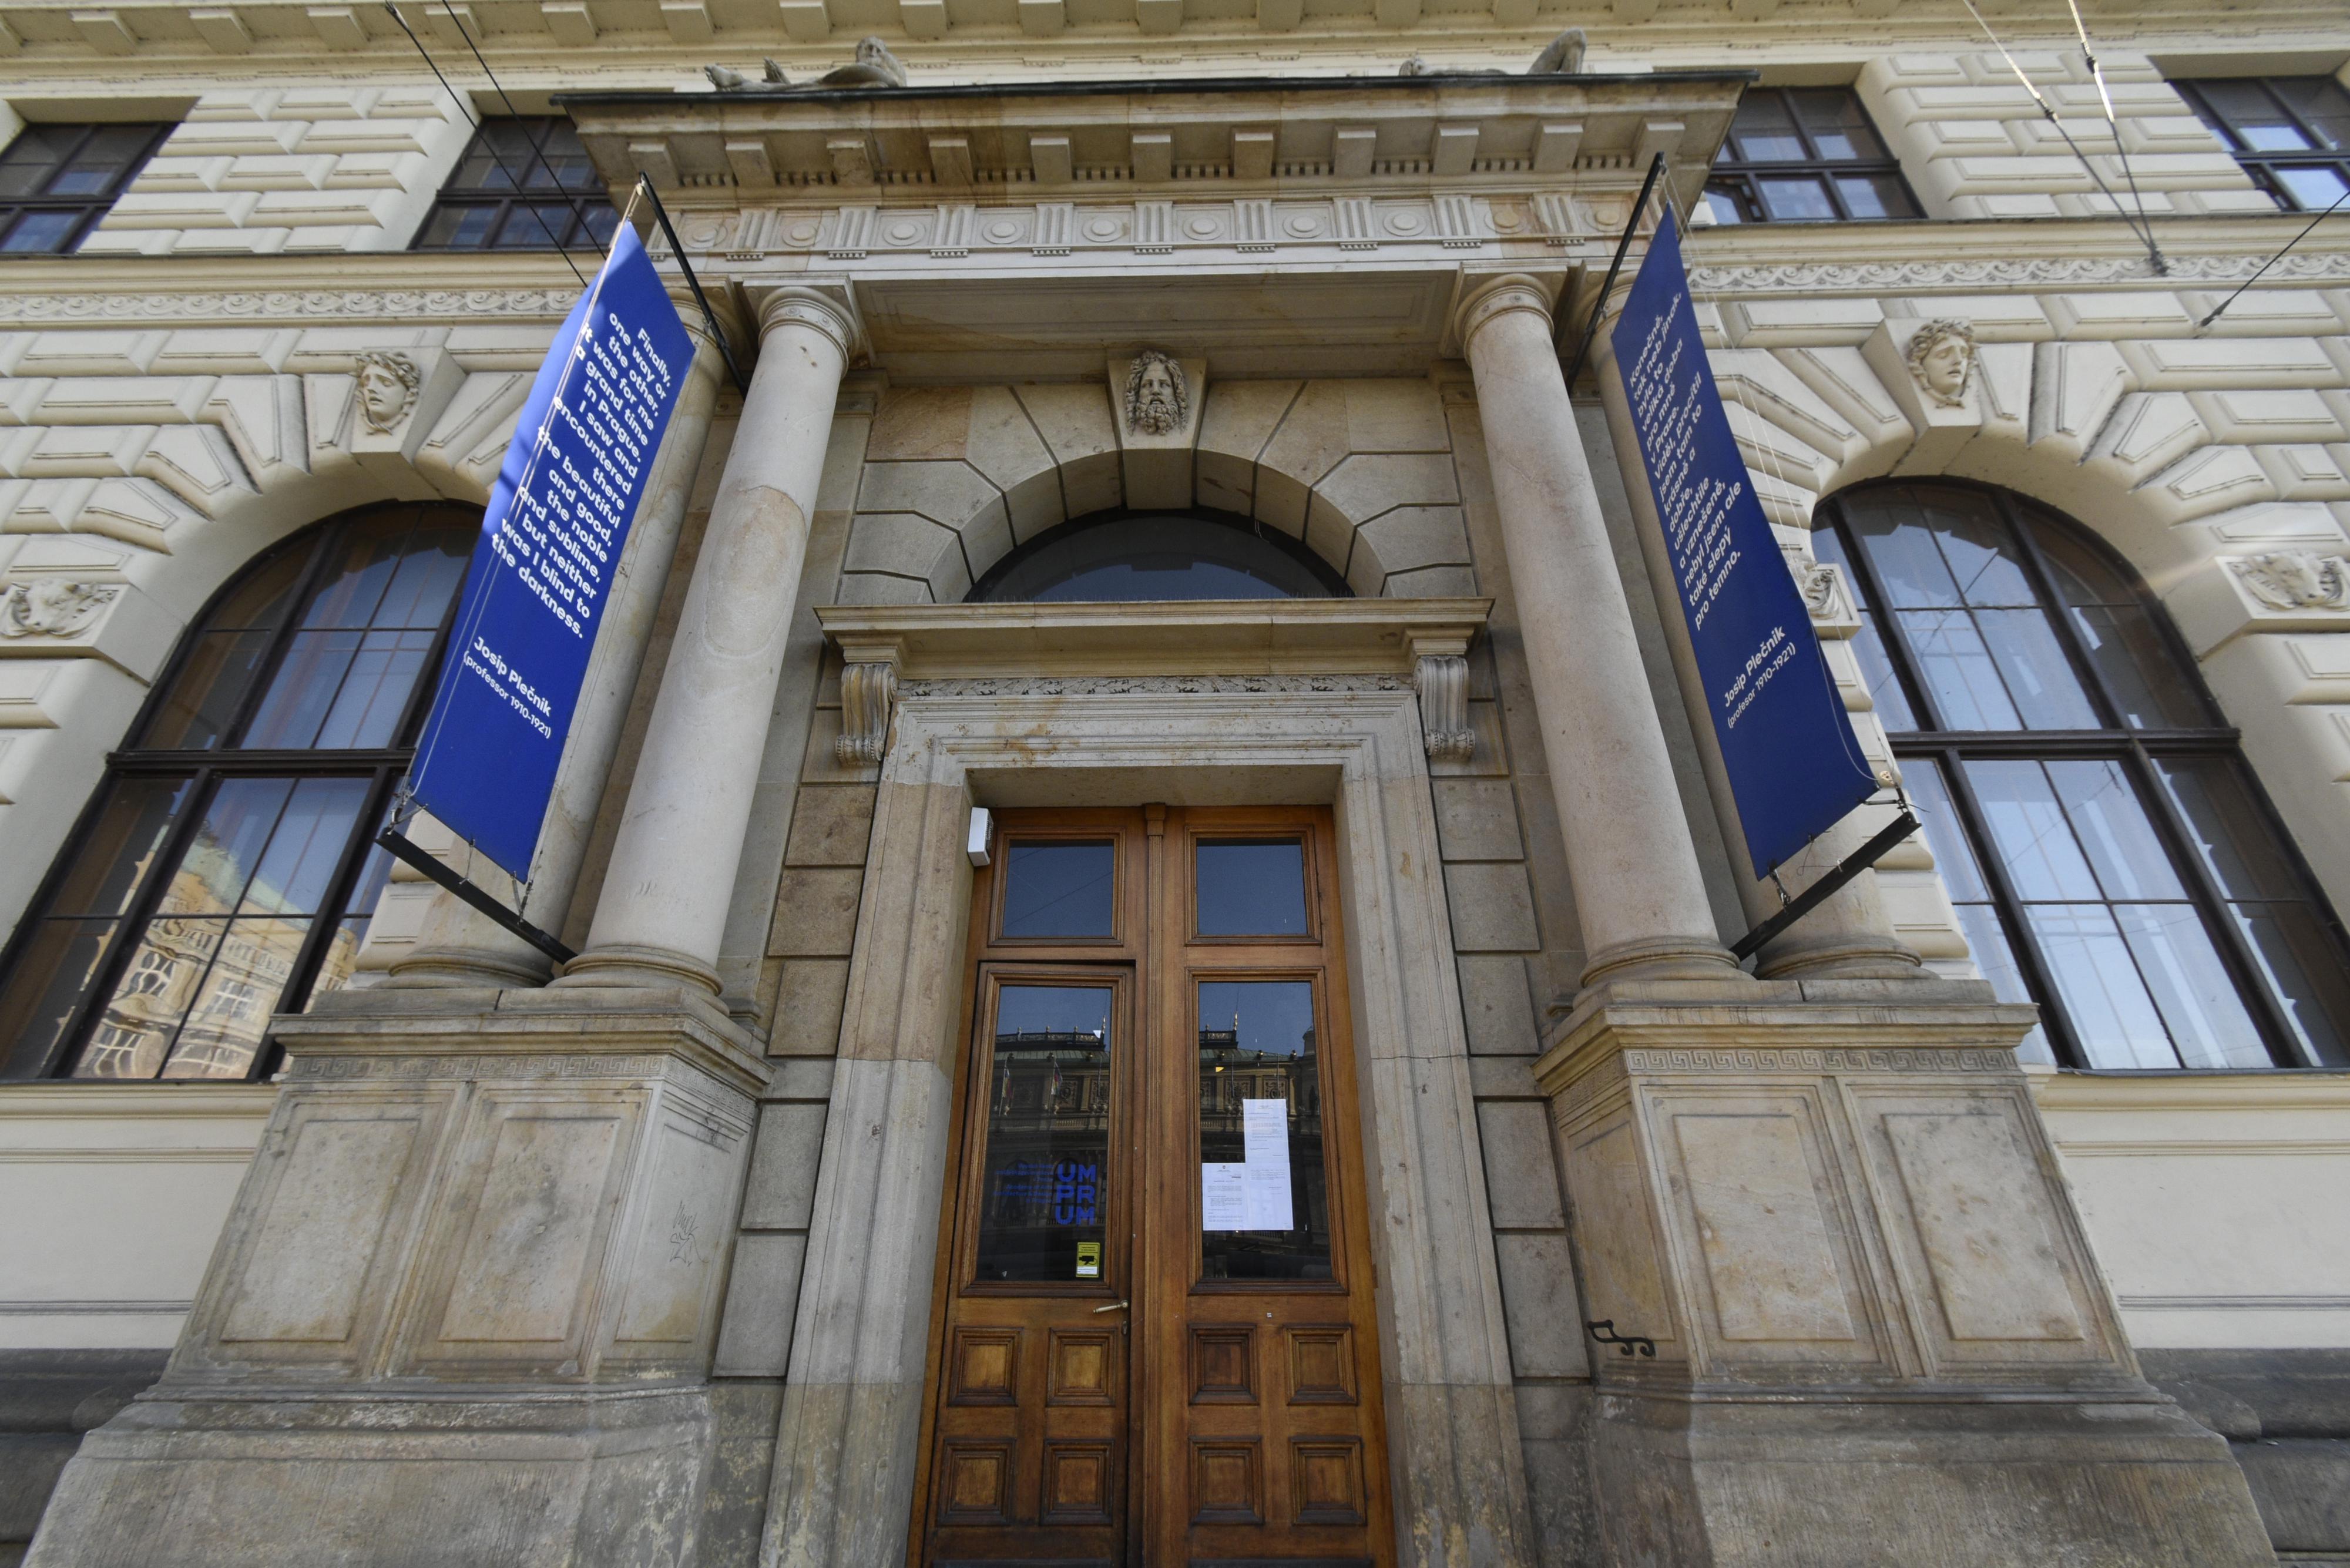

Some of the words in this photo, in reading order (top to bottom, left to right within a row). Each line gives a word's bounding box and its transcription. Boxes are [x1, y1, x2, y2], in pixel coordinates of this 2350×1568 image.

[580, 323, 593, 343] it
[593, 341, 618, 380] was
[619, 378, 637, 404] for
[637, 405, 654, 431] me
[609, 313, 632, 346] one
[632, 345, 655, 383] way
[655, 382, 667, 400] or
[609, 335, 629, 368] the
[629, 369, 659, 417] other,
[637, 327, 671, 388] Finally,
[1630, 314, 1663, 388] Konečně,
[1634, 374, 1647, 401] tak
[1646, 340, 1662, 374] neb
[1661, 292, 1682, 343] jinak,
[1642, 383, 1664, 432] veliká
[1664, 338, 1683, 384] doba
[575, 345, 586, 361] a
[586, 361, 624, 411] grand
[624, 408, 648, 446] time
[583, 380, 597, 403] in
[597, 399, 642, 463] Prague.
[1637, 382, 1654, 418] byla
[1654, 362, 1663, 381] to
[1646, 421, 1659, 452] pro
[1658, 381, 1676, 421] mně
[1654, 437, 1676, 480] Viděl,
[1676, 371, 1702, 439] procítil
[553, 396, 632, 495] encountered
[579, 399, 586, 413] I
[586, 412, 614, 447] saw
[614, 447, 638, 479] and
[1650, 452, 1656, 464] v
[1655, 405, 1680, 453] Praze.
[1659, 461, 1677, 502] jsem
[1676, 425, 1693, 459] tam
[1691, 404, 1702, 424] to
[538, 426, 560, 459] the
[562, 455, 620, 529] beautiful
[549, 469, 577, 503] and
[576, 501, 612, 548] good,
[592, 466, 625, 511] there
[1663, 459, 1689, 516] krásně
[1689, 446, 1696, 461] a
[1669, 487, 1693, 533] dobře,
[1674, 476, 1710, 550] ušlechtile
[519, 486, 548, 522] and
[548, 519, 600, 583] sublime,
[522, 513, 548, 549] but
[549, 545, 597, 599] neither
[546, 489, 569, 522] the
[571, 520, 607, 563] noble
[1680, 555, 1686, 569] a
[1685, 478, 1726, 556] vznešeně,
[1684, 543, 1705, 589] nebyl
[1703, 509, 1725, 554] jsem
[1724, 481, 1742, 511] ale
[491, 533, 516, 568] the
[518, 566, 583, 639] darkness.
[502, 518, 531, 557] was
[532, 551, 540, 566] I
[540, 559, 575, 603] blind
[576, 597, 590, 619] to
[1688, 569, 1708, 607] také
[1707, 525, 1732, 574] slepý
[1694, 600, 1710, 632] pro
[1708, 550, 1741, 602] temno.
[463, 650, 510, 700] (professor
[510, 695, 552, 740] 1910-1921)
[474, 636, 508, 675] Josip
[508, 669, 552, 717] Plečnik
[1724, 673, 1747, 707] Josip
[1745, 626, 1786, 677] Plečnik
[1727, 688, 1756, 730] (profesor
[1755, 642, 1797, 691] 1910-1921)
[1056, 1185, 1096, 1204] PR
[1058, 1163, 1097, 1183] UM
[1055, 1206, 1096, 1226] UM
